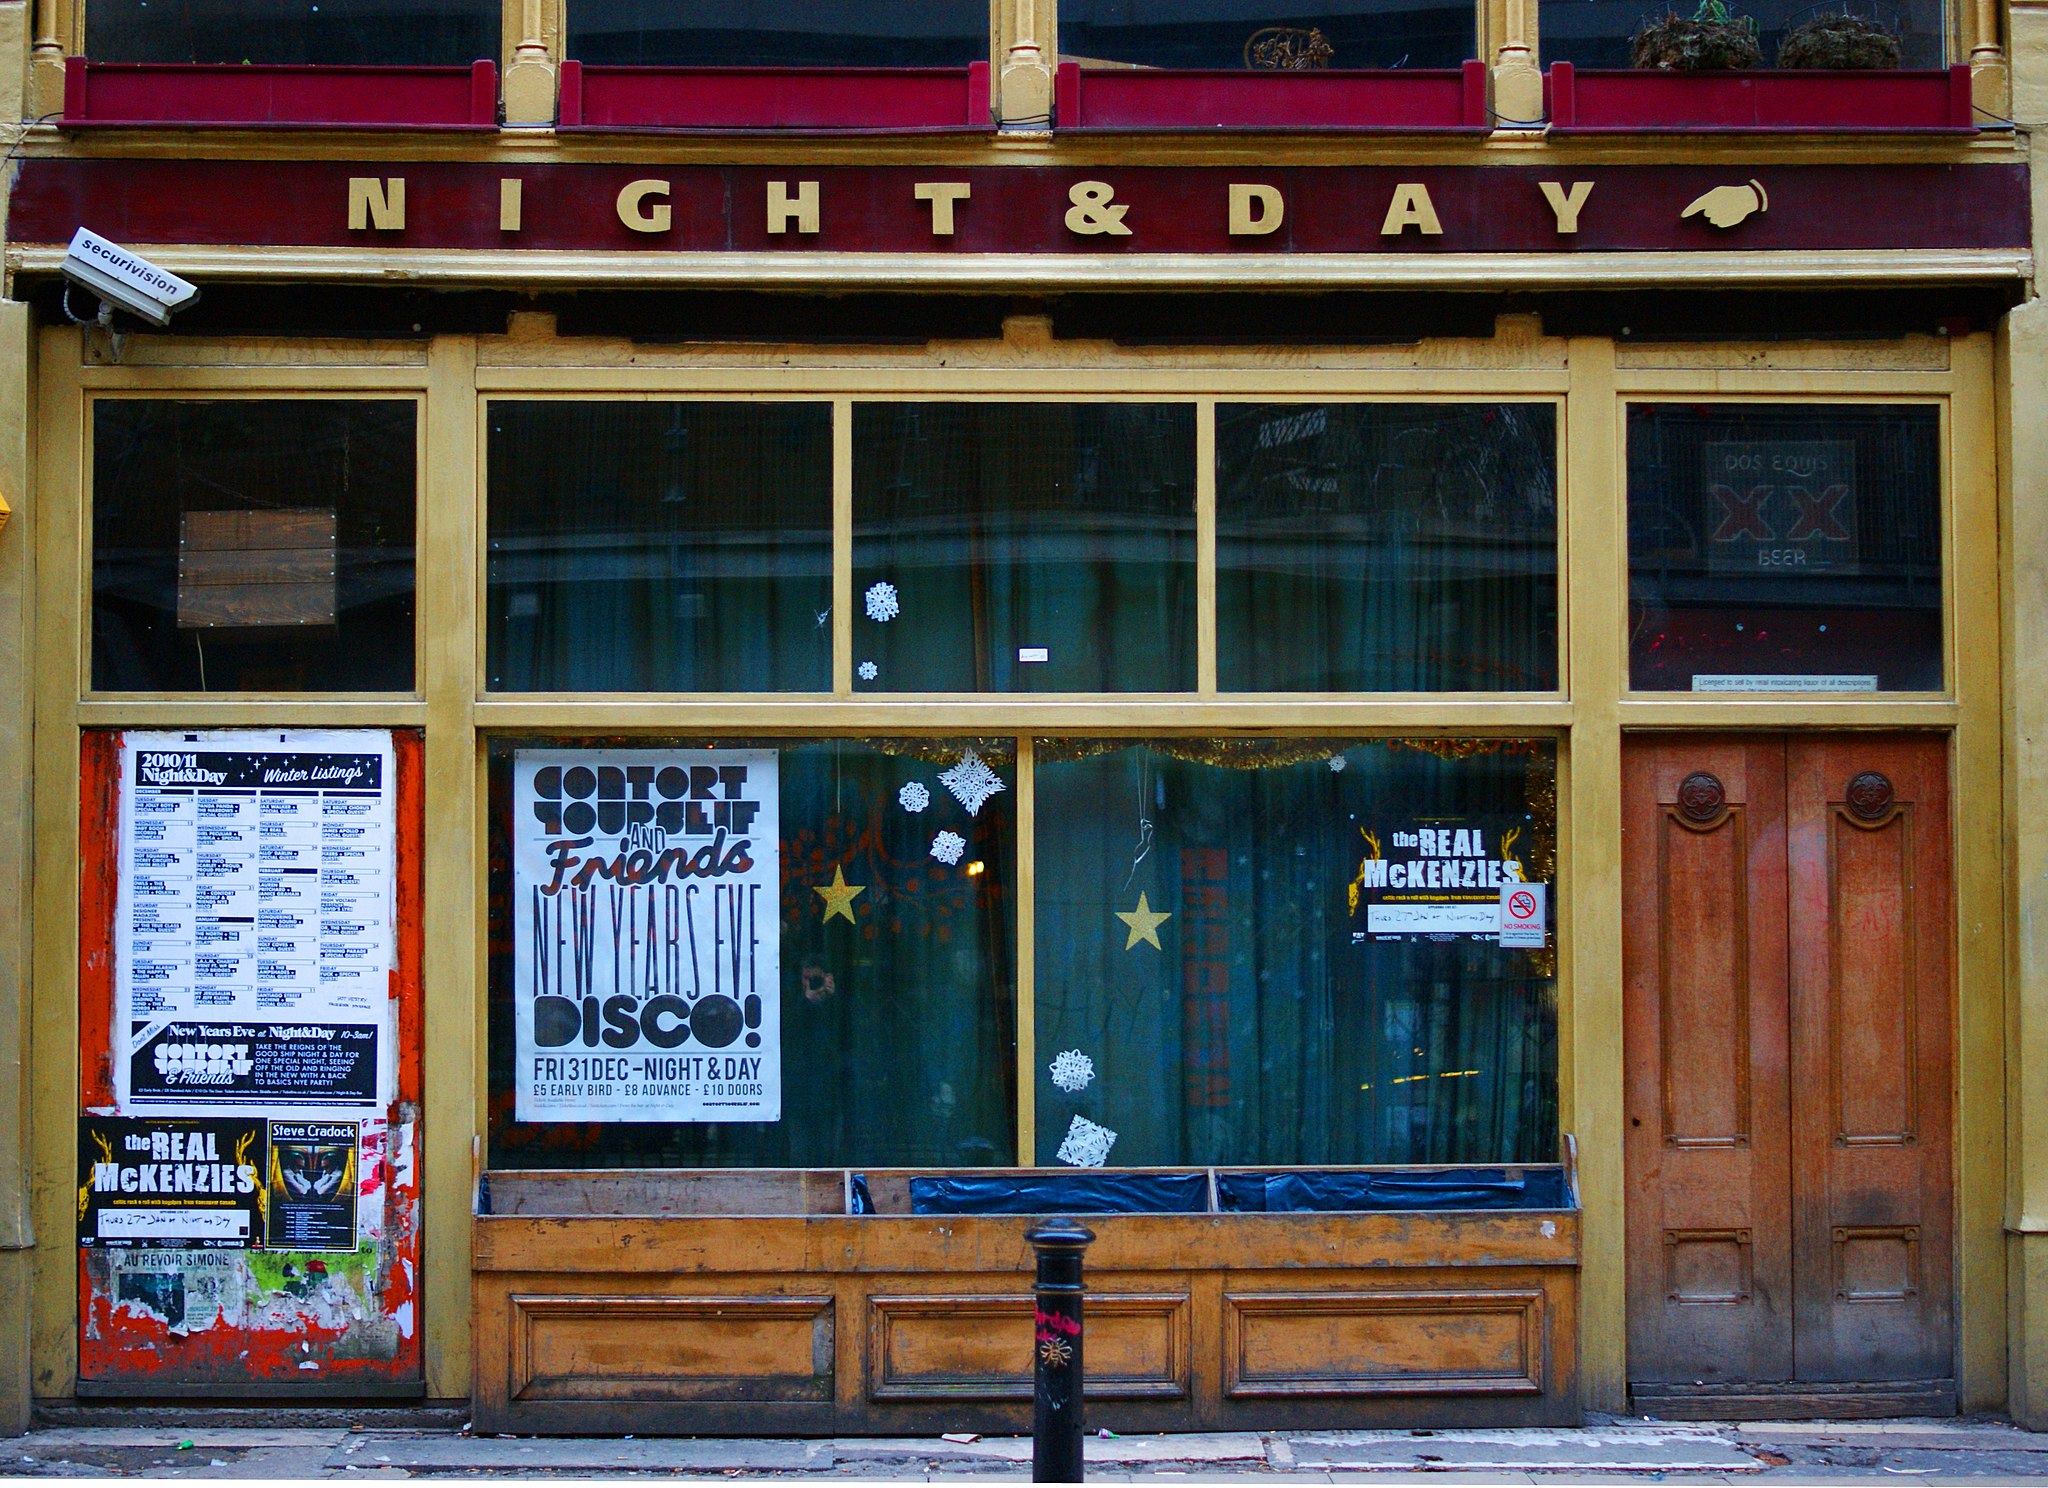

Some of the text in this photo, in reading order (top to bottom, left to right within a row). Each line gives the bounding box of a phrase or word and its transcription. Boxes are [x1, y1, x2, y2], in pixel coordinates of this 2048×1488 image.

[348, 177, 1595, 235] NIGHT & DAY
[82, 239, 177, 295] securivision
[1725, 454, 1829, 476] DOS EQUIS
[1759, 550, 1806, 566] BEER
[142, 753, 197, 770] 2010/11
[142, 768, 228, 786] Night&Day
[264, 765, 364, 785] Winter Listings
[534, 766, 748, 800] CONTORT
[534, 801, 761, 835] YOURSELF
[629, 823, 666, 855] AND
[1392, 828, 1486, 857] the REAL
[540, 827, 754, 896] Friends
[1363, 859, 1520, 889] McKENZIES
[533, 884, 762, 1000] NEW YEARS EVE
[169, 1024, 374, 1041] New Years Eve at Night&Day 10-3am!
[534, 993, 762, 1049] DISCO!
[154, 1043, 249, 1060] CONTORT
[255, 1043, 272, 1051] TAKE
[274, 1043, 287, 1051] THE
[289, 1043, 315, 1051] REIGNS
[317, 1043, 327, 1051] OF
[165, 1067, 235, 1085] & Friends
[534, 1057, 565, 1081] FRI
[707, 1057, 721, 1081] &
[725, 1057, 762, 1081] DAY
[533, 1084, 547, 1096] £5
[551, 1084, 584, 1096] EARLY
[587, 1084, 613, 1096] BIRD
[625, 1084, 638, 1096] £8
[642, 1084, 691, 1096] ADVANCE
[703, 1084, 724, 1096] £10
[728, 1084, 763, 1096] DOORS
[272, 1124, 355, 1138] Steve Cradock
[125, 1131, 220, 1162] the REAL
[94, 1162, 255, 1194] McKENZIES
[124, 1253, 229, 1267] AU REVOIR SIMONE
